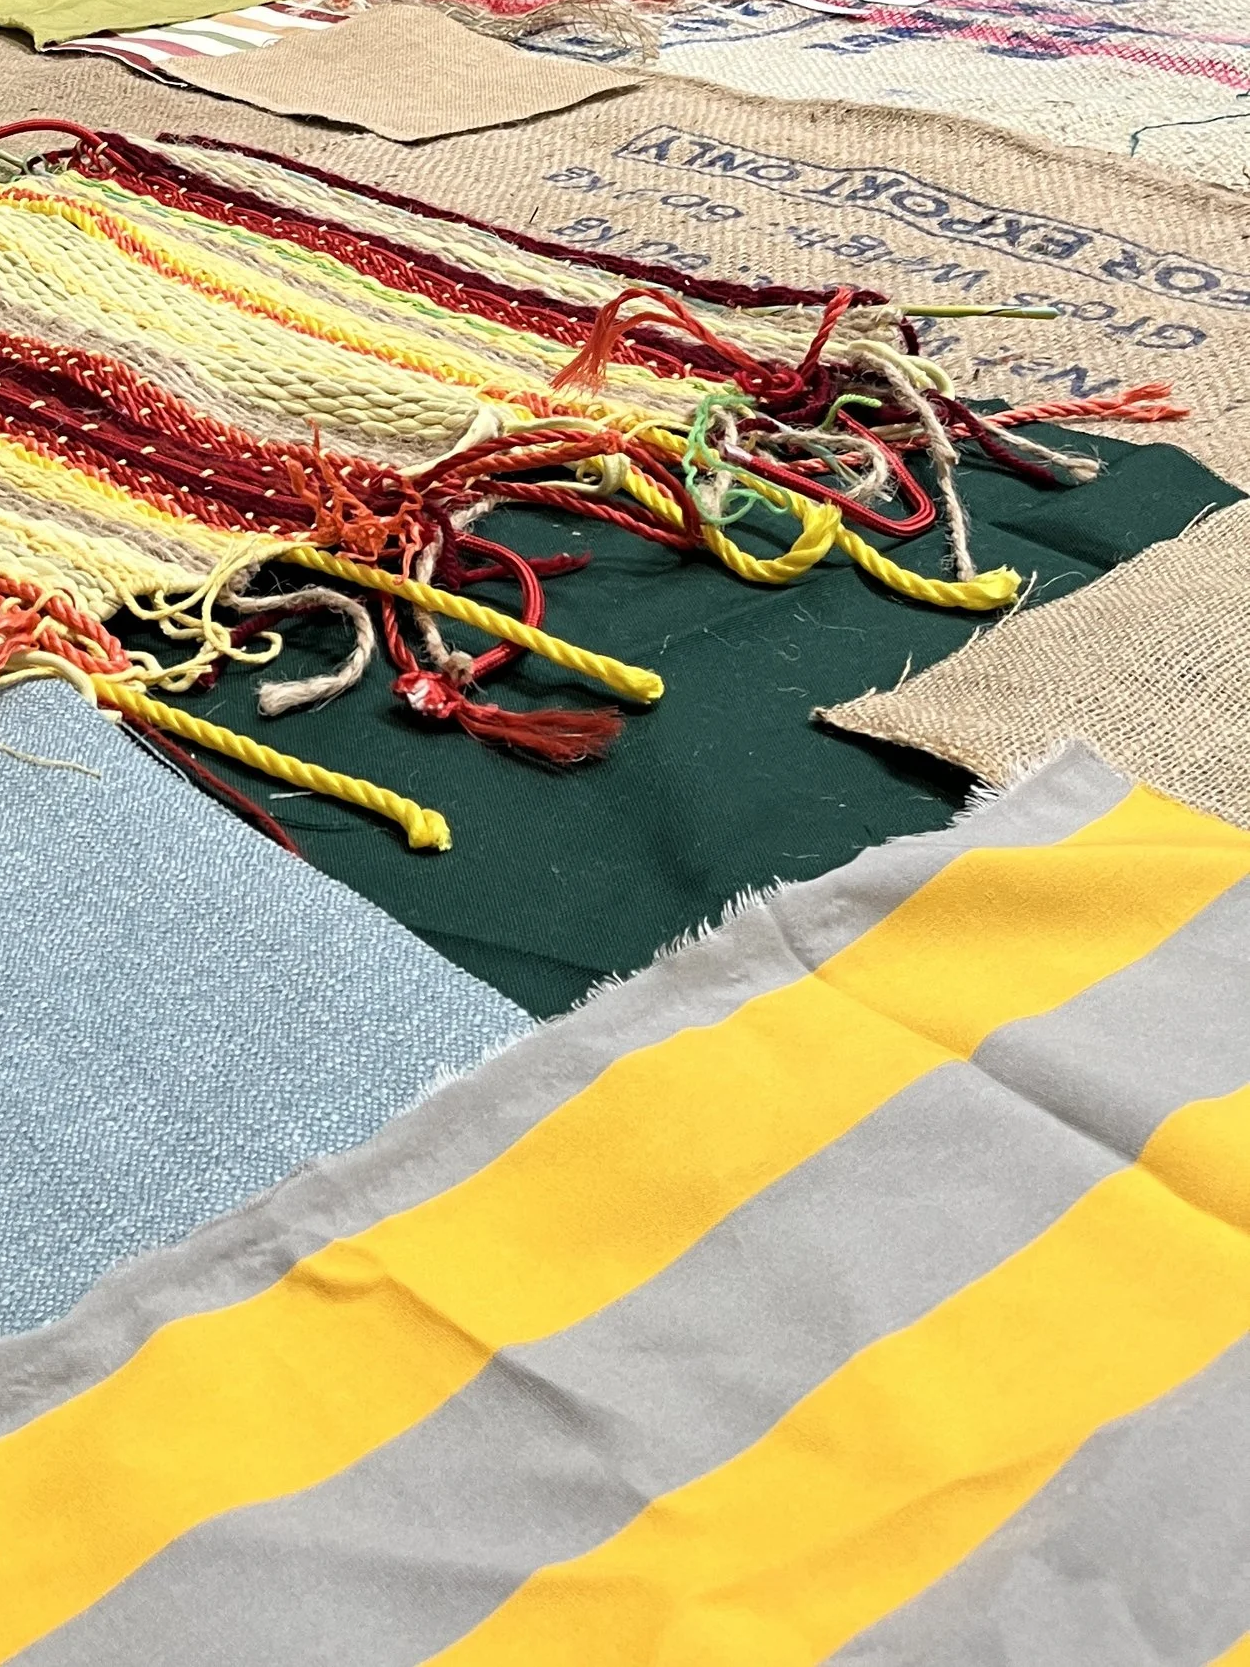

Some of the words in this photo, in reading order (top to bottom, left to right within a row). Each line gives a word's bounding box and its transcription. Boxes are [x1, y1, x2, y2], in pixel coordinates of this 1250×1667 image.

[633, 136, 800, 182] ONLY
[801, 175, 1094, 259] EXPORT
[1101, 248, 1250, 306] FOR
[1003, 291, 1208, 350] Gross
